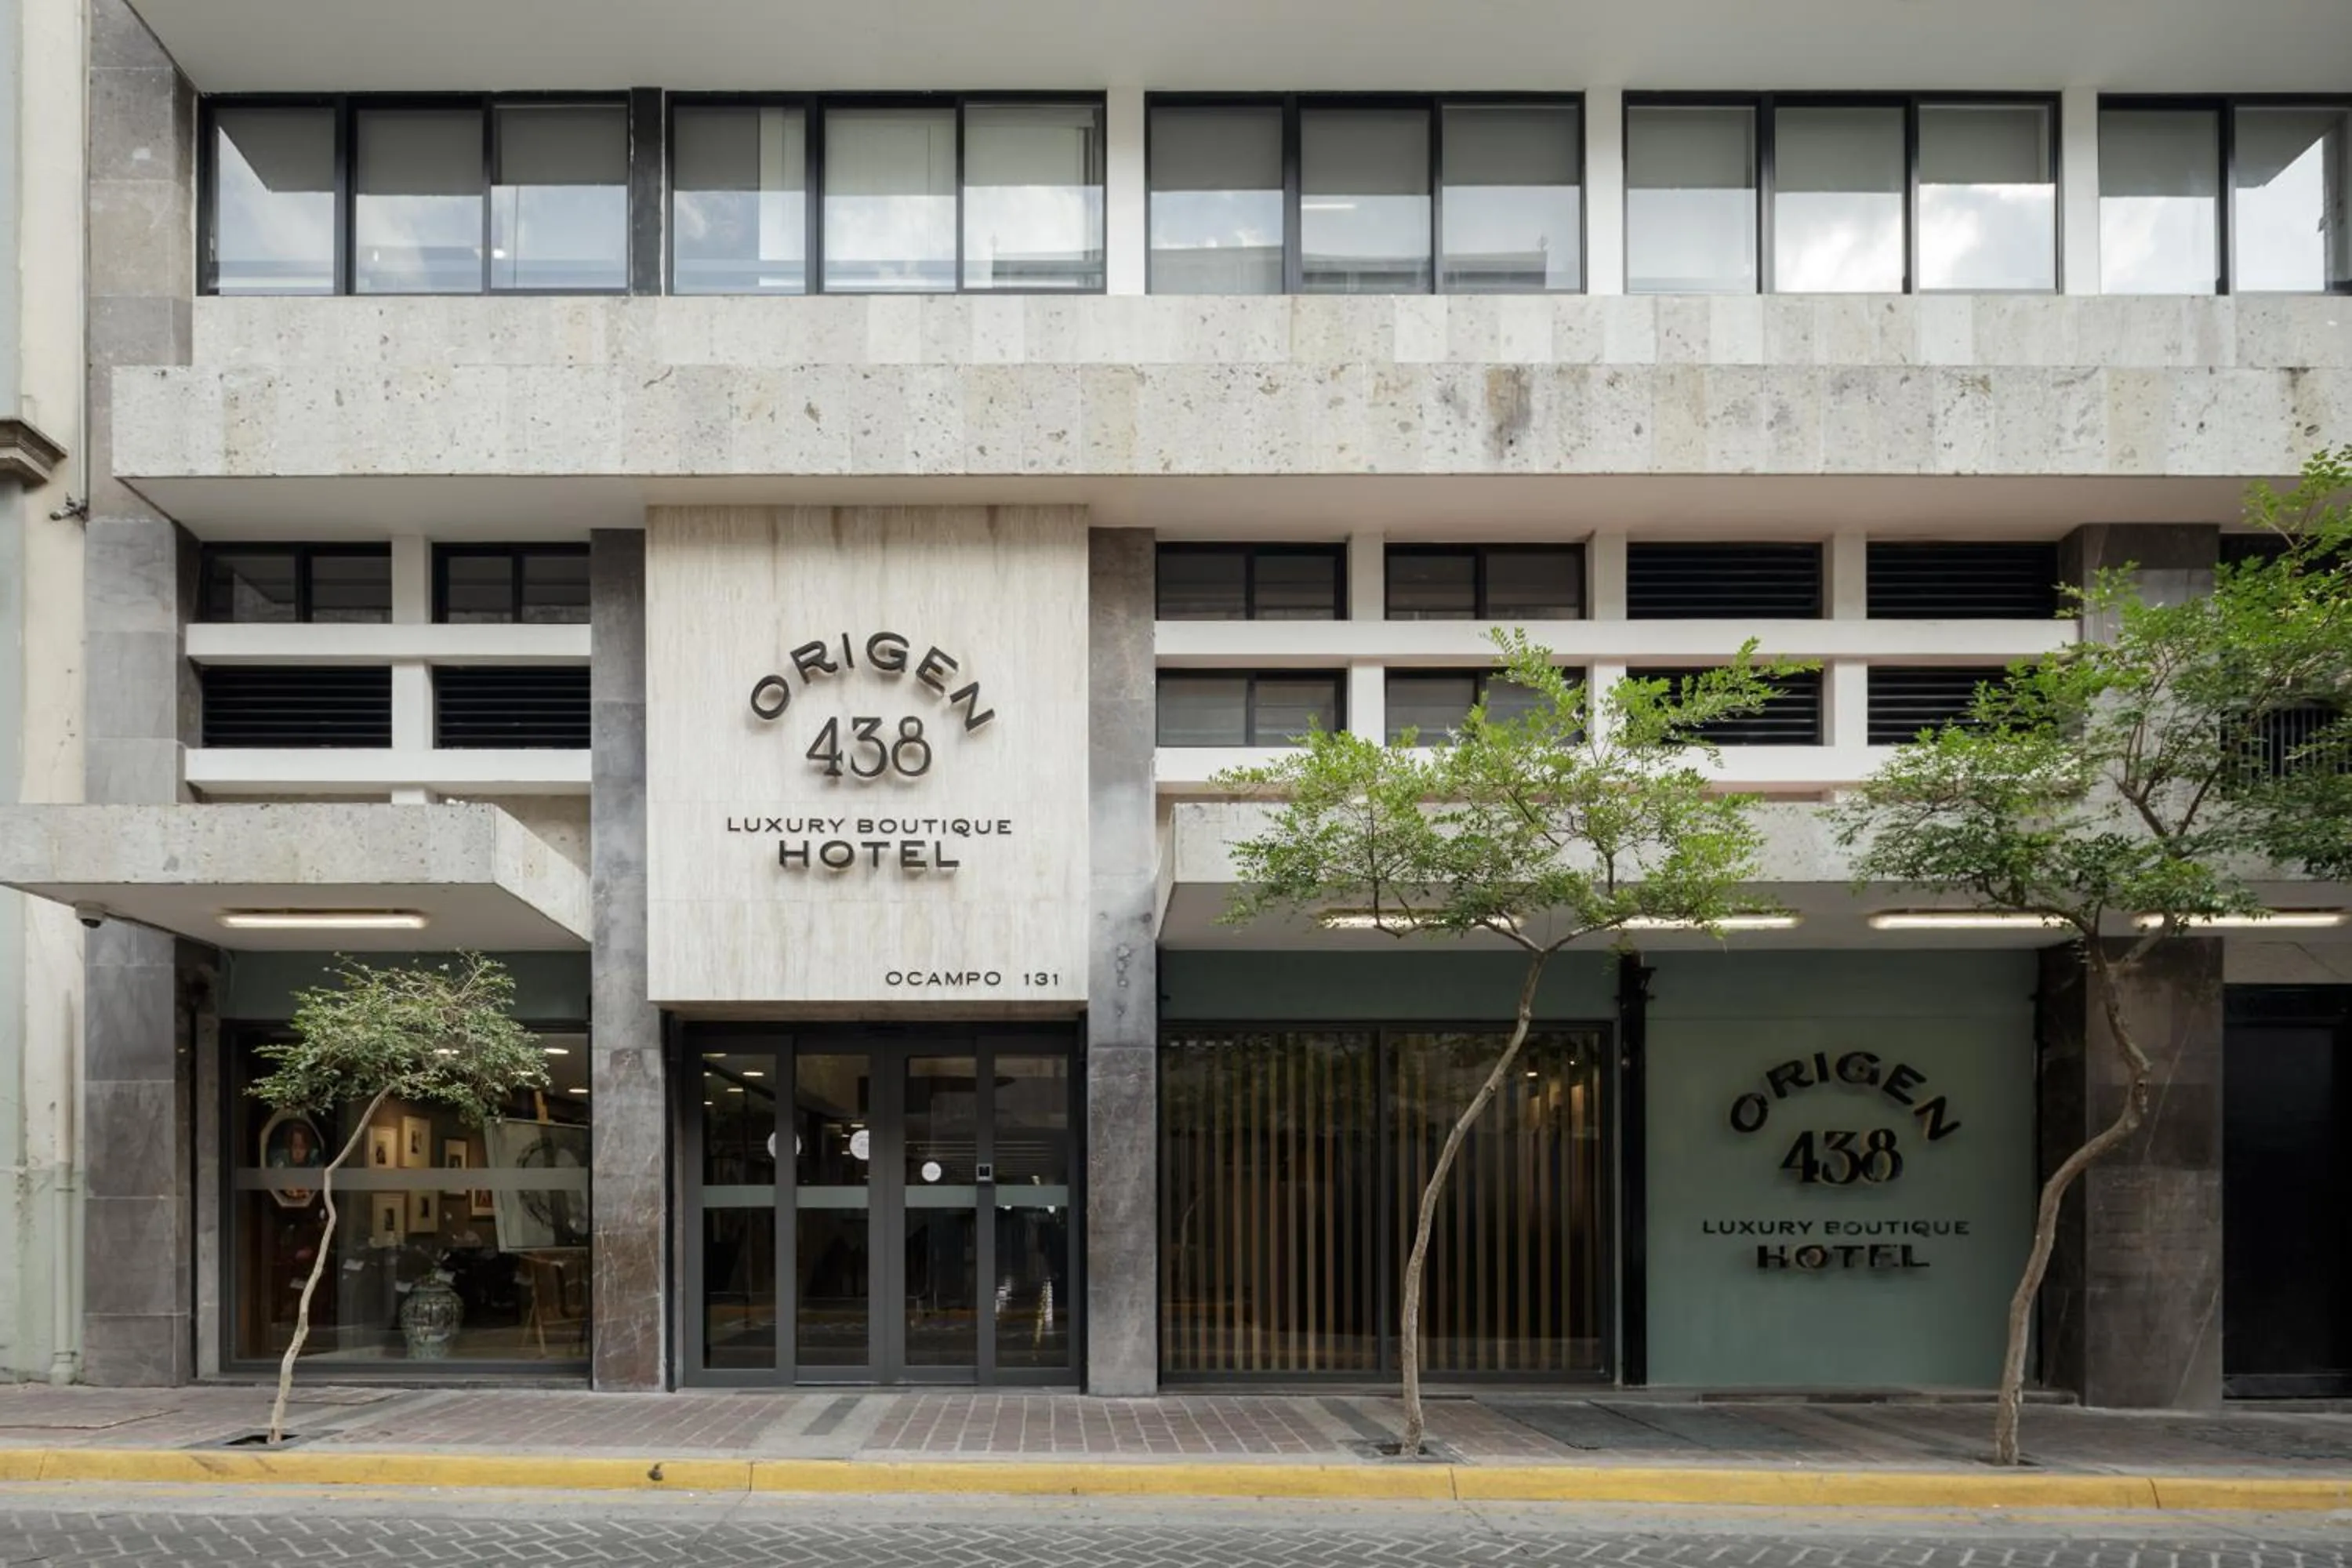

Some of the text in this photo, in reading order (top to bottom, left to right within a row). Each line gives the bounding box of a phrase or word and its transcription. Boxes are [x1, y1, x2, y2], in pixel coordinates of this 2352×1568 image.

[750, 631, 995, 731] ORIGEN
[806, 717, 931, 778] 438
[728, 817, 1012, 838] LUXURY BOUTIQUE
[779, 840, 960, 869] HOTEL
[885, 971, 1060, 986] OCAMPO 131
[1730, 1051, 1961, 1142] ORIGEN
[1780, 1129, 1904, 1185] 438
[1703, 1221, 1970, 1237] LUXURY BOUTIQUE
[1758, 1244, 1930, 1269] HOTEL
